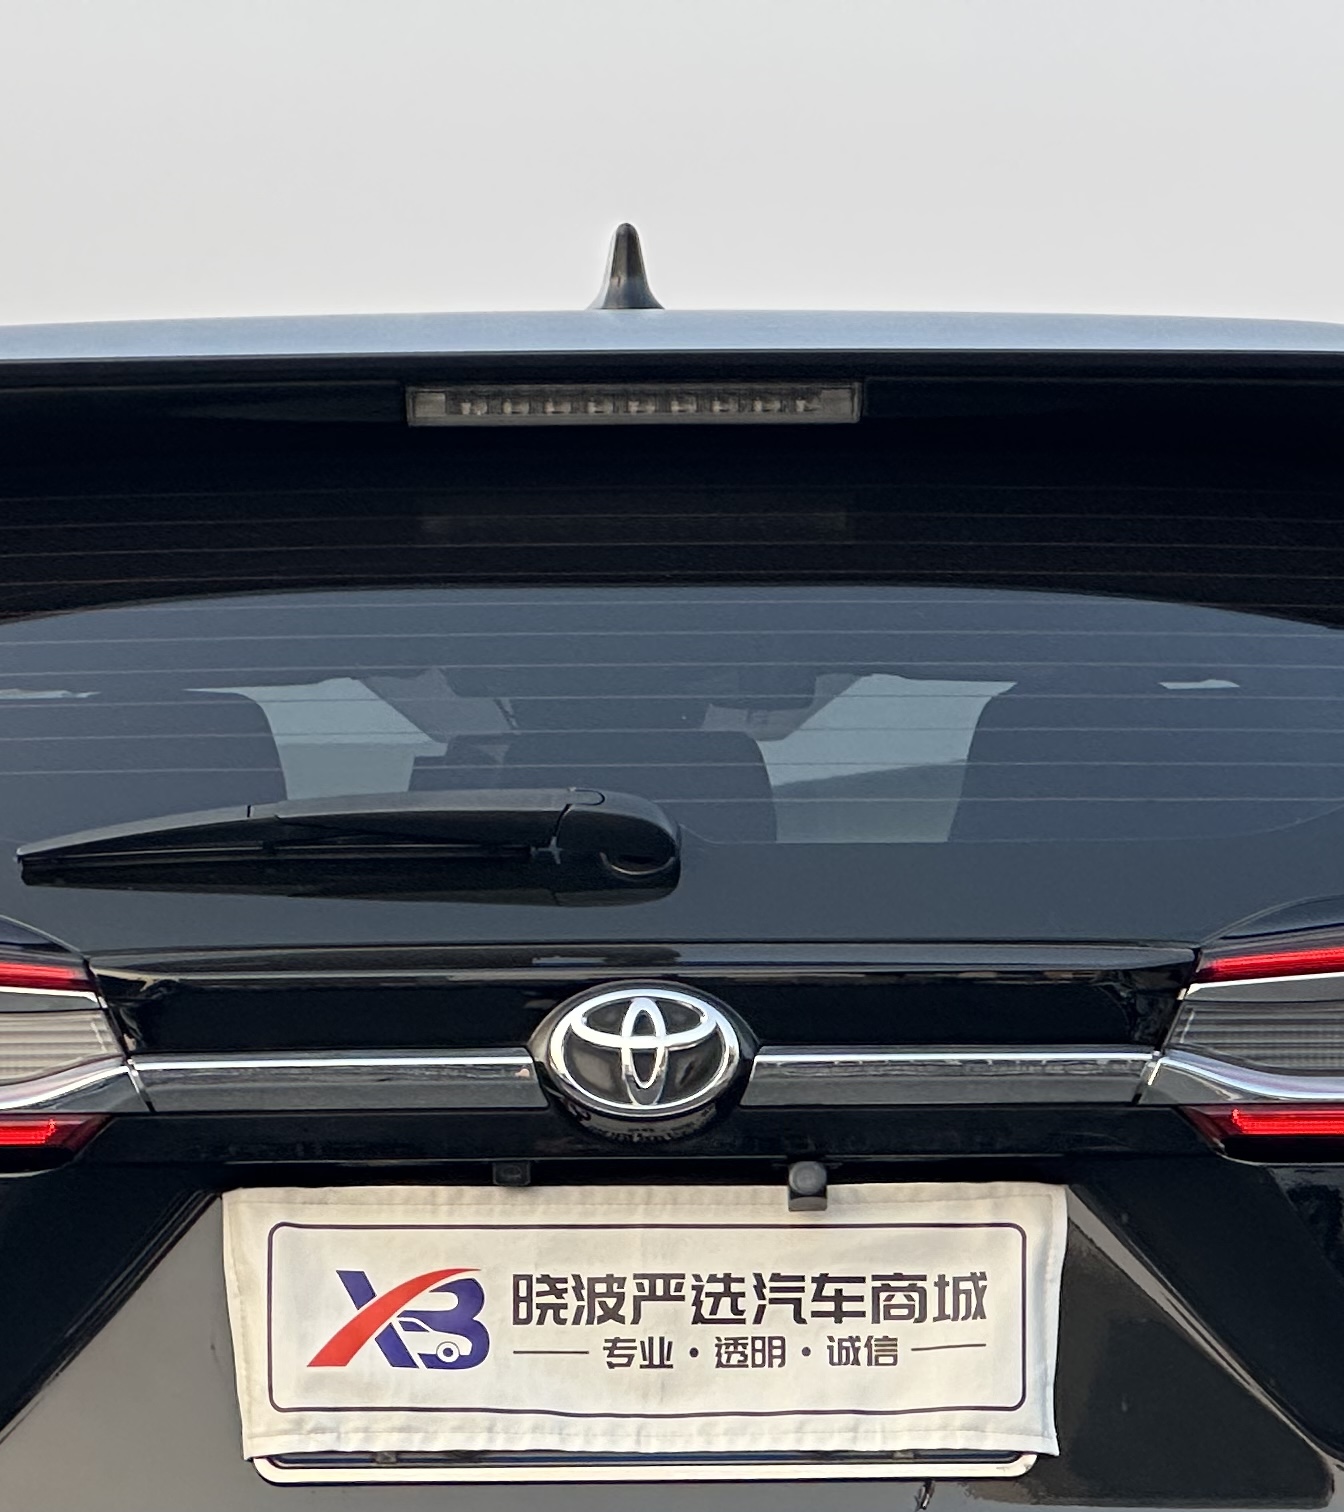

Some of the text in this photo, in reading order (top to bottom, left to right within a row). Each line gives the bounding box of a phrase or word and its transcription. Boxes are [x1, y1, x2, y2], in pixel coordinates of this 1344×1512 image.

[512, 1270, 988, 1327] 晓波严选汽车商城
